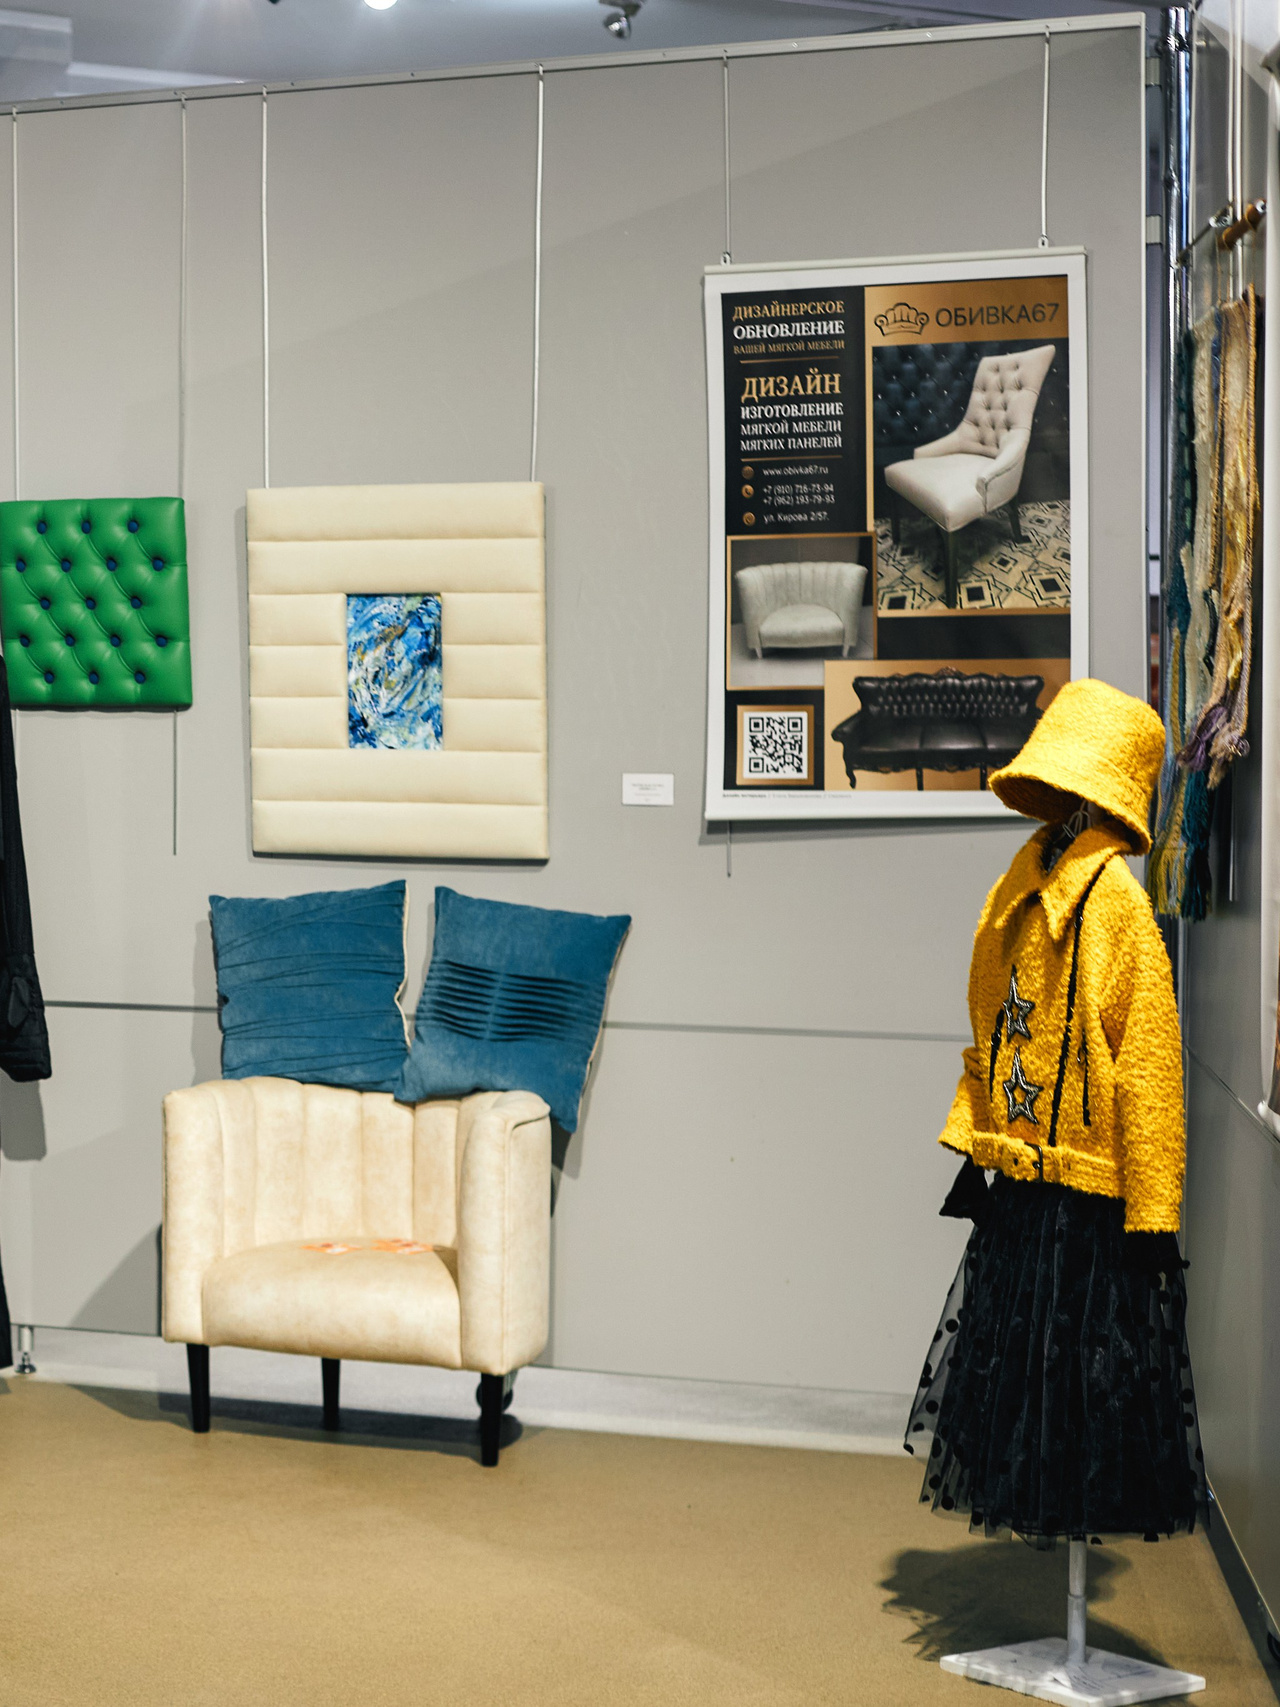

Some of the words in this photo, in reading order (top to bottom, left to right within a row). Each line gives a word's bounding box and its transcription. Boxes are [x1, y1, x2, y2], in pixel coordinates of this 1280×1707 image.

[732, 300, 845, 322] ДИЗАЙНЕРСКОЕ
[935, 303, 1060, 327] ОБИВКА67
[733, 320, 845, 340] ОБНОВЛЕНИЕ
[733, 342, 766, 355] ВАШЕЙ
[768, 340, 805, 353] МЯГКОЙ
[807, 339, 845, 350] МЕБЕЛИ
[741, 367, 841, 403] ДИЗАЙН
[740, 402, 844, 419] ИЗГОТОВЛЕНИЕ
[740, 419, 789, 436] МЯГКОЙ
[792, 420, 842, 433] МЕБЕЛИ
[740, 439, 785, 451] МЯГКИХ
[787, 434, 842, 449] ПАНЕЛЕЙ
[762, 465, 829, 476] www.obivka67.ru
[777, 512, 808, 523] Кирова
